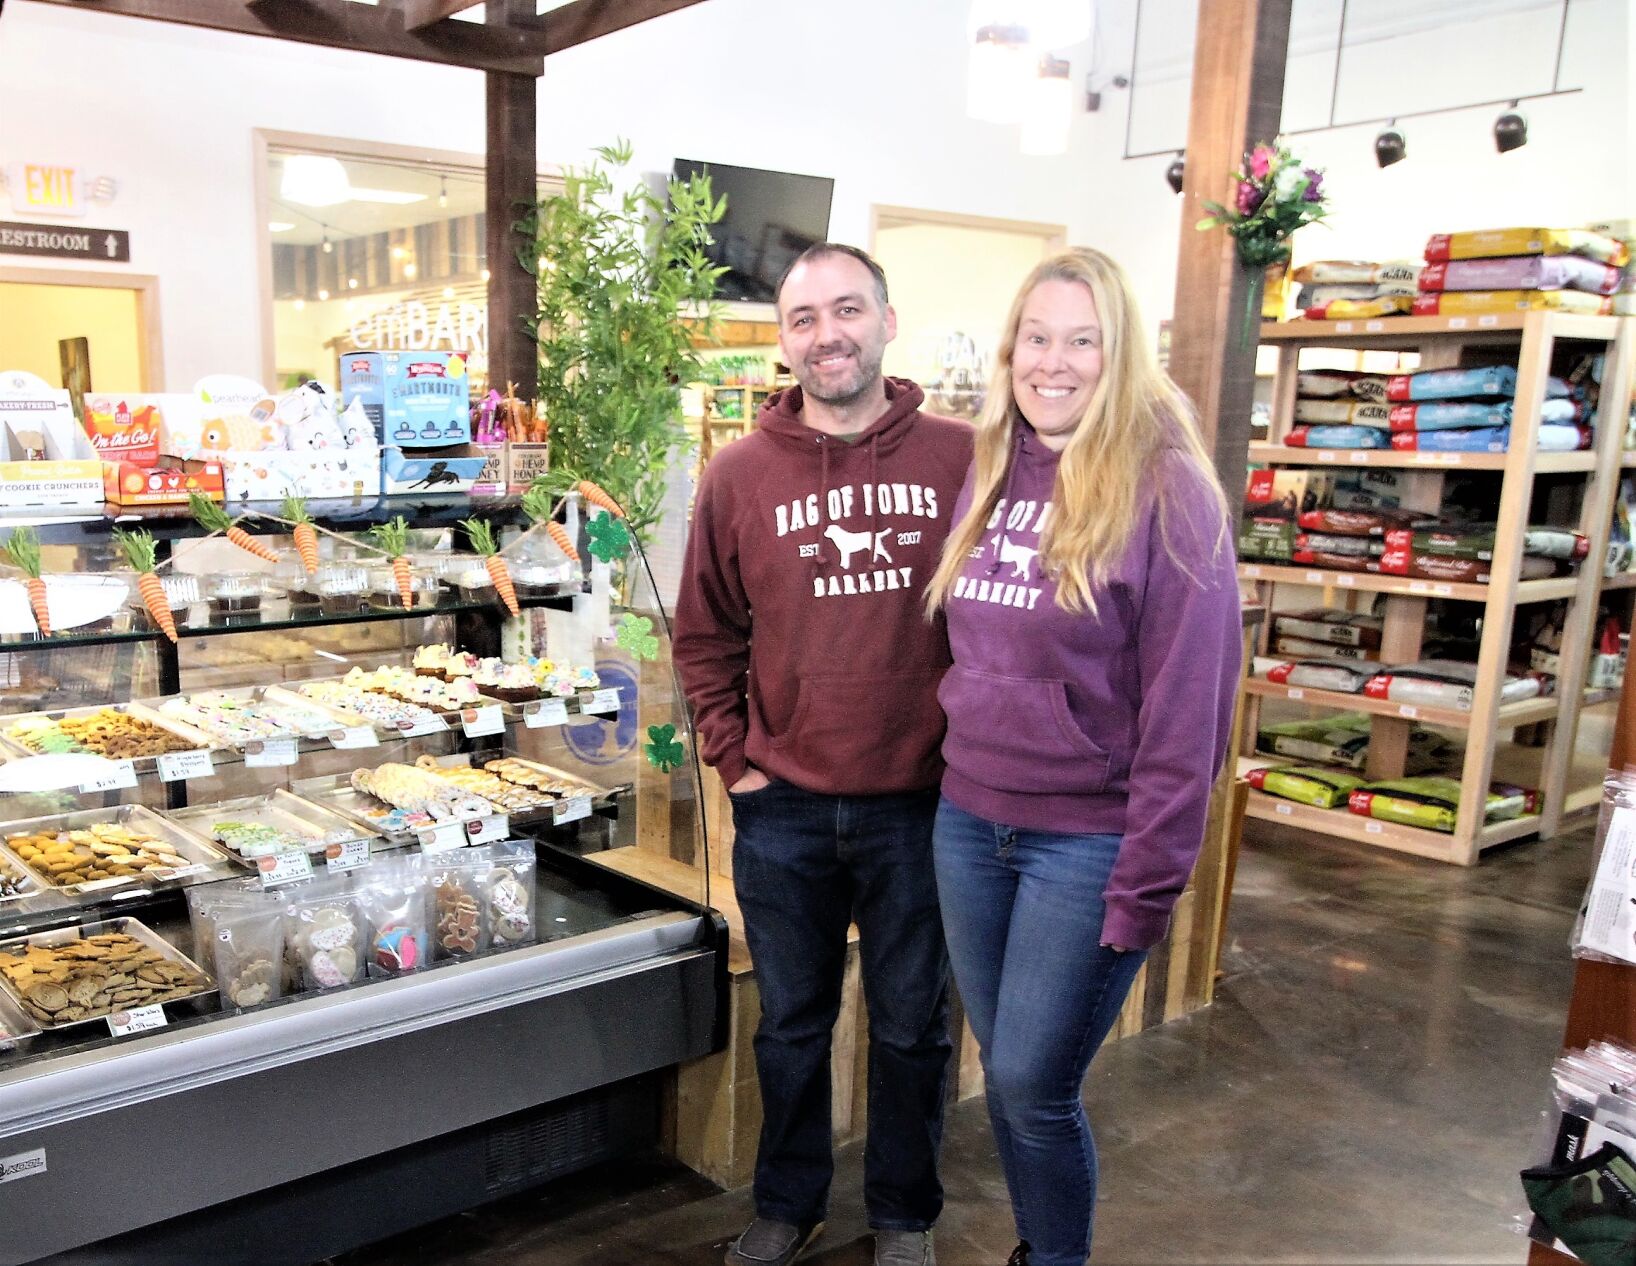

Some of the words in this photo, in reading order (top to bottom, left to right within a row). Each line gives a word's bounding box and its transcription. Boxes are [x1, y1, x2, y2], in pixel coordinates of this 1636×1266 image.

[25, 164, 75, 208] EXIT
[0, 229, 90, 250] ESTROOM
[350, 302, 487, 351] emBAR
[92, 433, 110, 449] On
[131, 428, 157, 445] Go!
[478, 469, 499, 479] NEY
[522, 460, 545, 468] HEMP
[44, 482, 99, 490] CRUNCHERS
[775, 493, 819, 537] BAG
[827, 485, 853, 520] OF
[798, 543, 820, 558] EST
[897, 531, 922, 545] 2007
[814, 567, 912, 597] BARKERY
